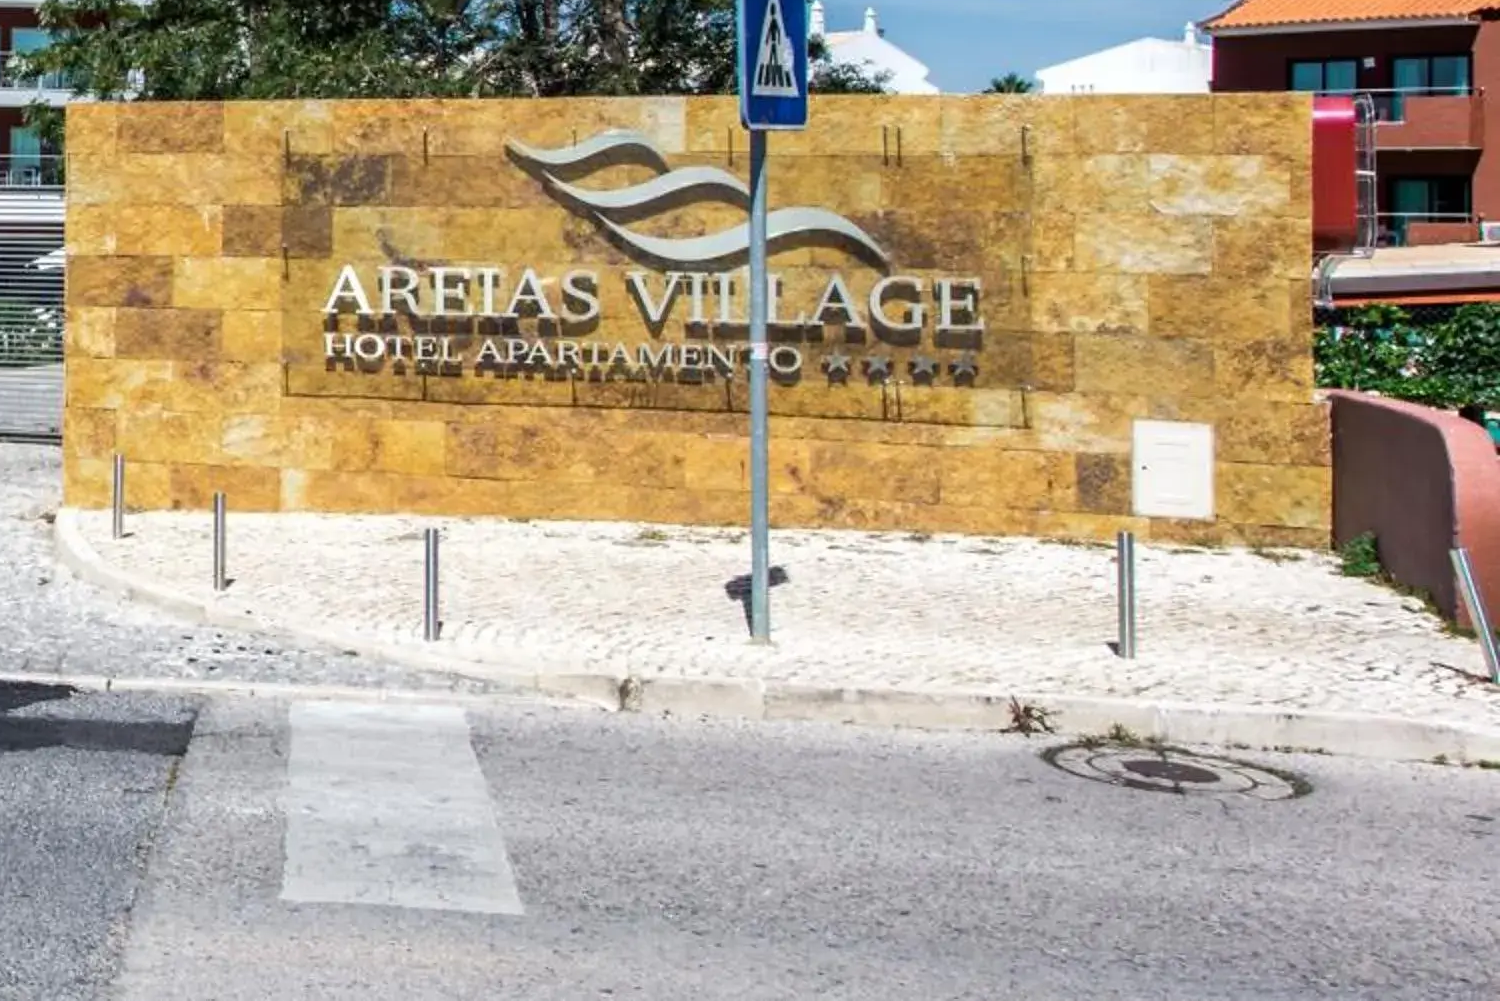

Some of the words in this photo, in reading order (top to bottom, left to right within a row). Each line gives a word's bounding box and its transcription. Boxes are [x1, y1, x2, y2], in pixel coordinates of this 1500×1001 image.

[321, 263, 600, 323] AREIAS
[625, 271, 985, 331] VILLAGE
[323, 332, 462, 362] HOTEL
[476, 338, 802, 373] APARTAMENO
